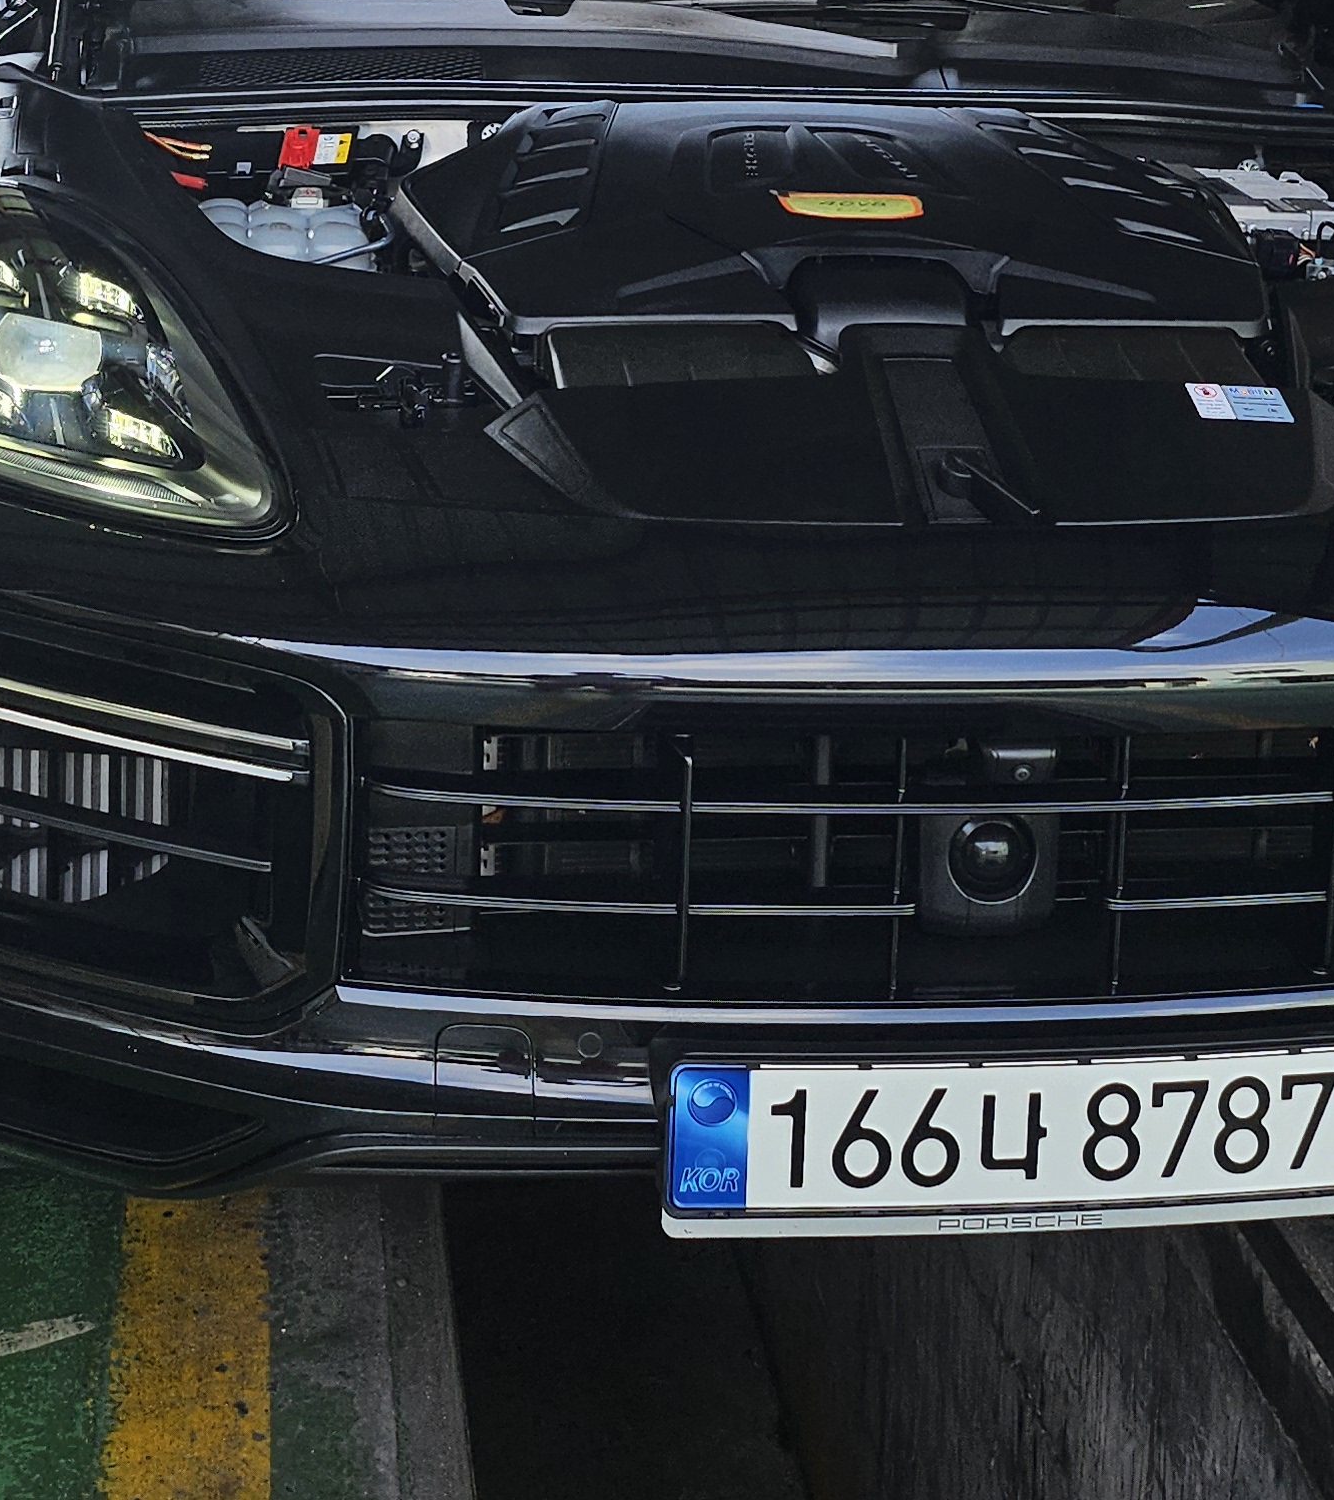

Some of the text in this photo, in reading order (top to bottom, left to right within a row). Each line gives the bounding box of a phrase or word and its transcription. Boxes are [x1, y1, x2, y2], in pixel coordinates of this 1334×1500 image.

[770, 1088, 1047, 1189] 166나
[679, 1167, 740, 1193] KOR
[938, 1213, 1103, 1231] PORSCHE
